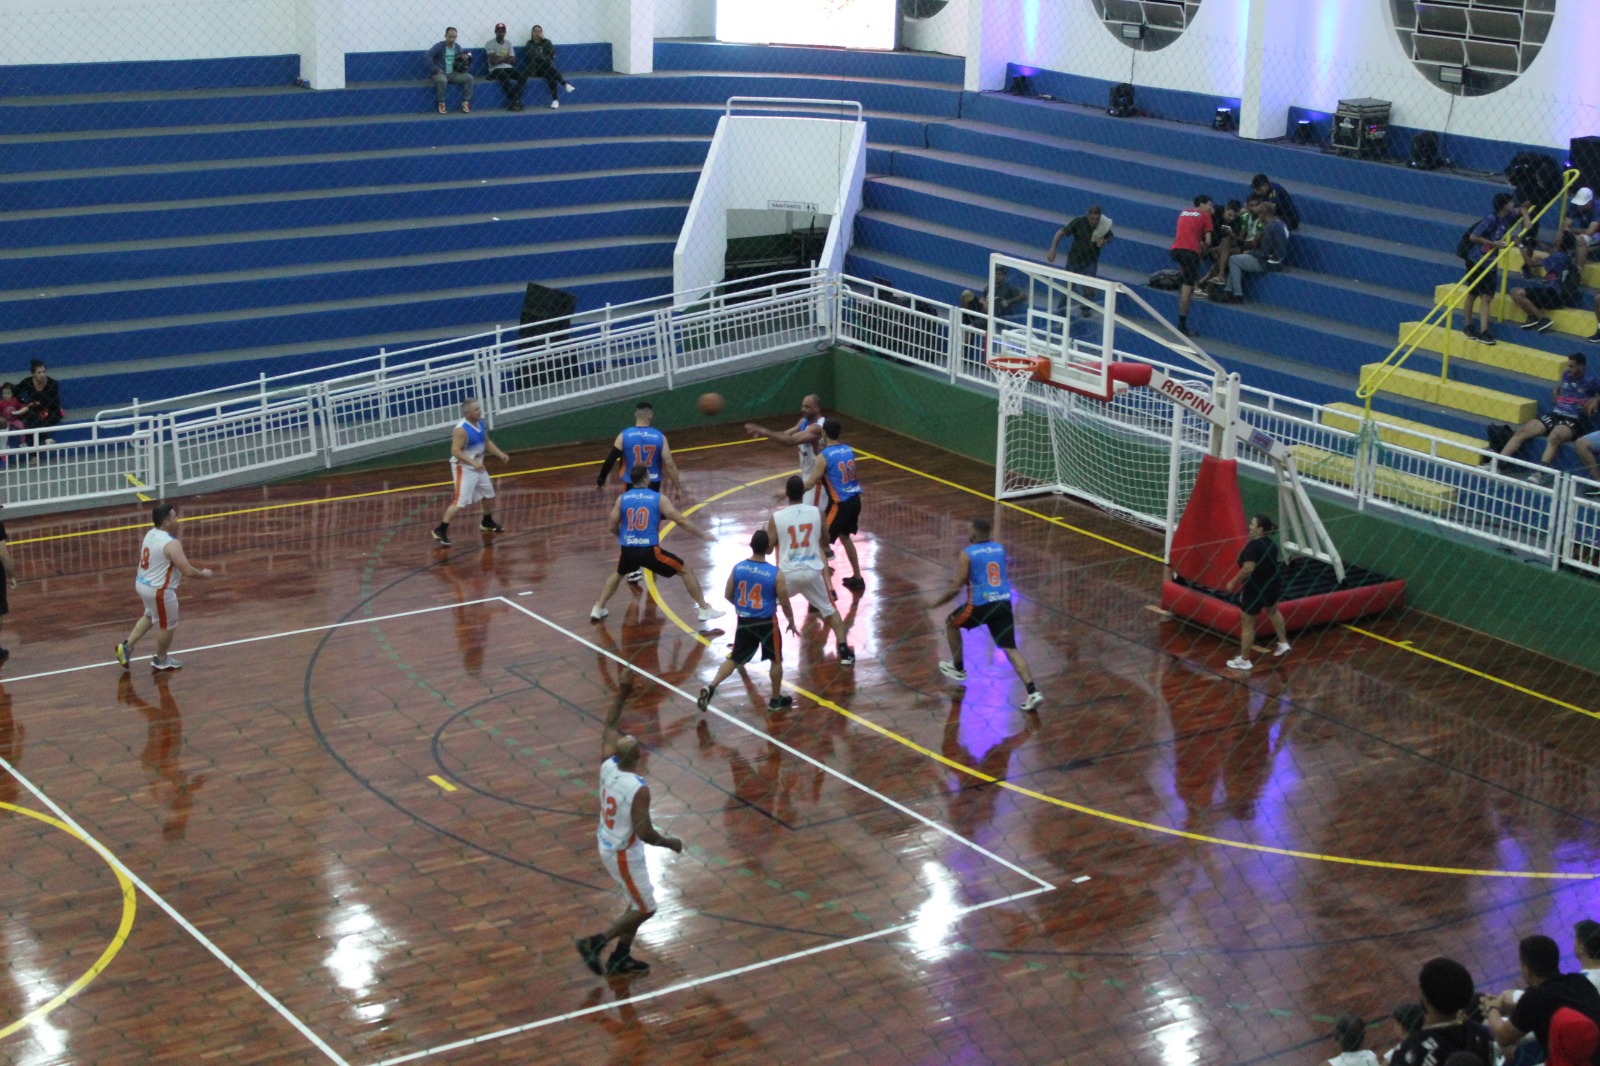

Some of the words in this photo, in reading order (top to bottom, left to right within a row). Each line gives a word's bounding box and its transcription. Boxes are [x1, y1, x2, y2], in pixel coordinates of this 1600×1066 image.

[1160, 379, 1215, 416] RAPINI
[633, 444, 656, 467] 17
[627, 507, 649, 531] 10
[787, 523, 813, 549] 17
[987, 561, 1001, 587] 8
[738, 580, 763, 609] 14
